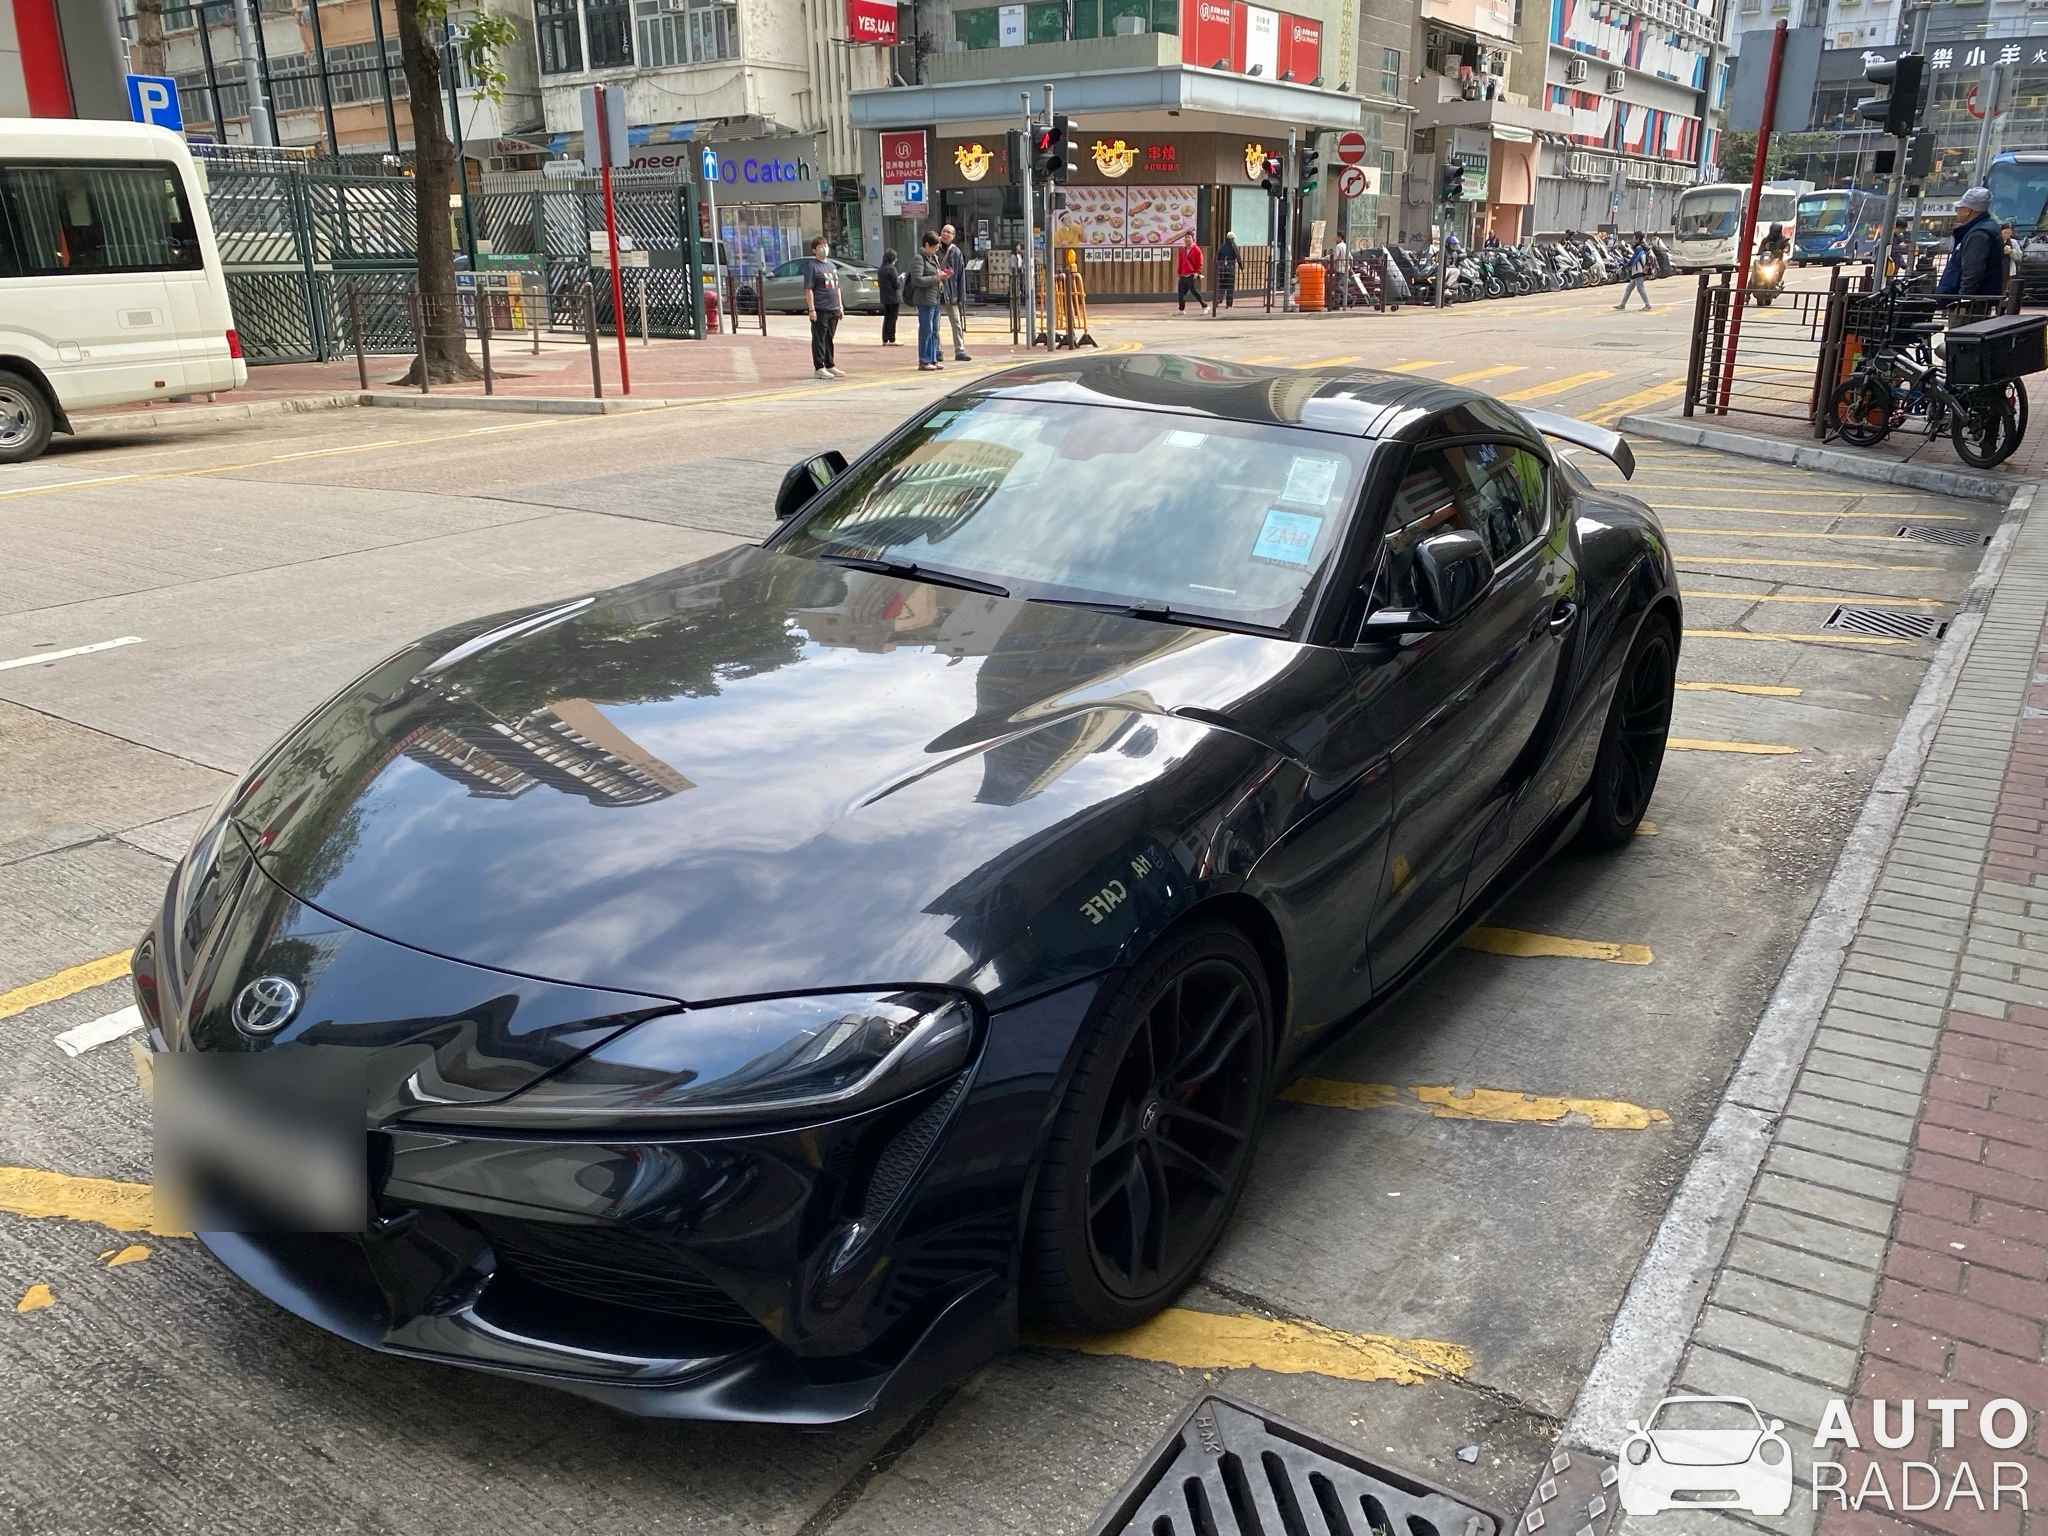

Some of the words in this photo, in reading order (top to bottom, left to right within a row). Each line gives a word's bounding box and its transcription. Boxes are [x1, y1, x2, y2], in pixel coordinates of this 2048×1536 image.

[138, 81, 169, 125] P
[1149, 145, 1176, 160] 串燒
[743, 156, 811, 184] Catch
[885, 170, 895, 178] UA
[896, 168, 923, 177] FINANCE
[908, 182, 920, 200] P
